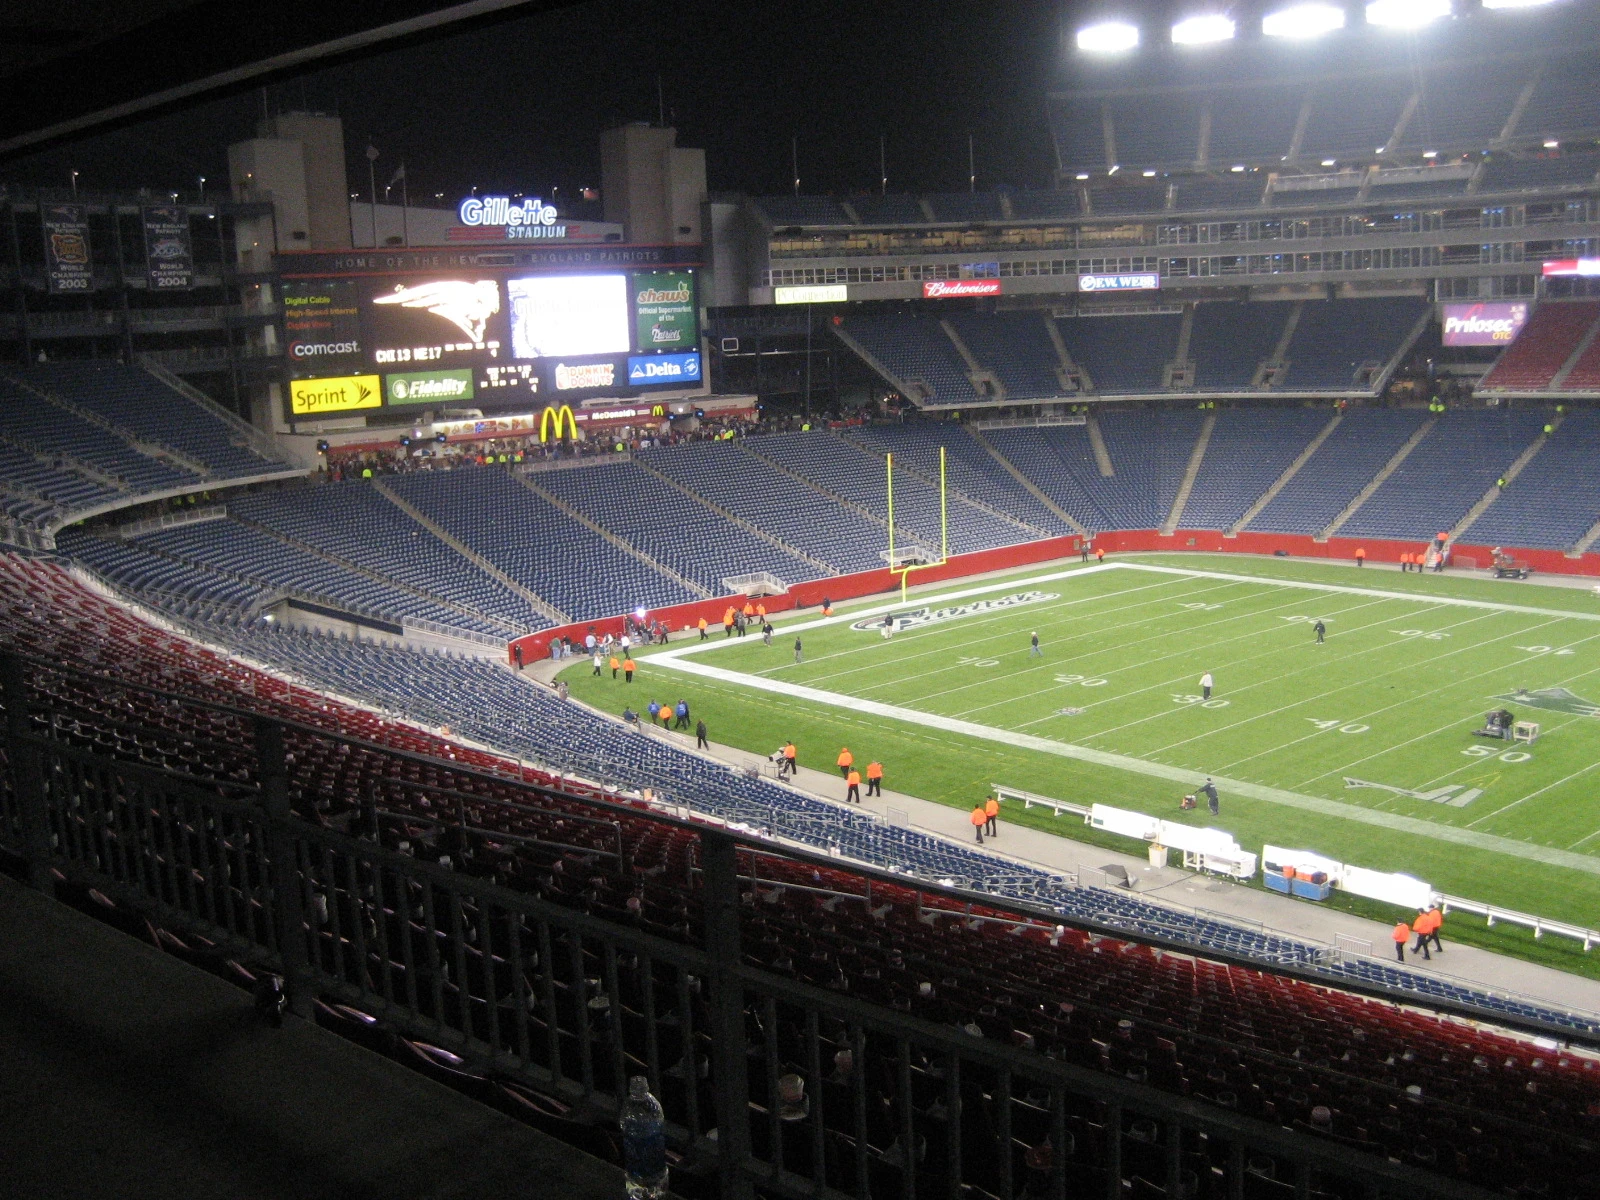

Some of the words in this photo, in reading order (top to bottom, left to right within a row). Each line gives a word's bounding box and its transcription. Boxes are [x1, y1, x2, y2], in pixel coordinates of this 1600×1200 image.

[461, 198, 558, 226] Gillette
[508, 226, 567, 239] STADIUM
[335, 257, 376, 269] HOME
[386, 256, 404, 268] OF
[414, 255, 440, 266] THE
[449, 253, 479, 265] NEW
[600, 250, 659, 261] PATRIOTS
[58, 279, 88, 289] 2003
[158, 277, 188, 287] 2004
[1119, 275, 1156, 288] WEBB
[925, 282, 999, 297] Budweiser
[284, 296, 308, 306] Digital
[309, 295, 331, 305] Cable
[1445, 316, 1513, 333] Prilosec
[1492, 331, 1512, 340] OTC
[290, 340, 359, 360] comcast
[397, 348, 411, 362] 13
[429, 346, 442, 359] 17
[645, 362, 681, 377] Delta
[410, 378, 467, 395] Fidelity
[570, 375, 612, 389] DONUTS
[296, 388, 347, 410] Sprint
[592, 409, 636, 420] McDonald's
[1460, 744, 1532, 763] 50
